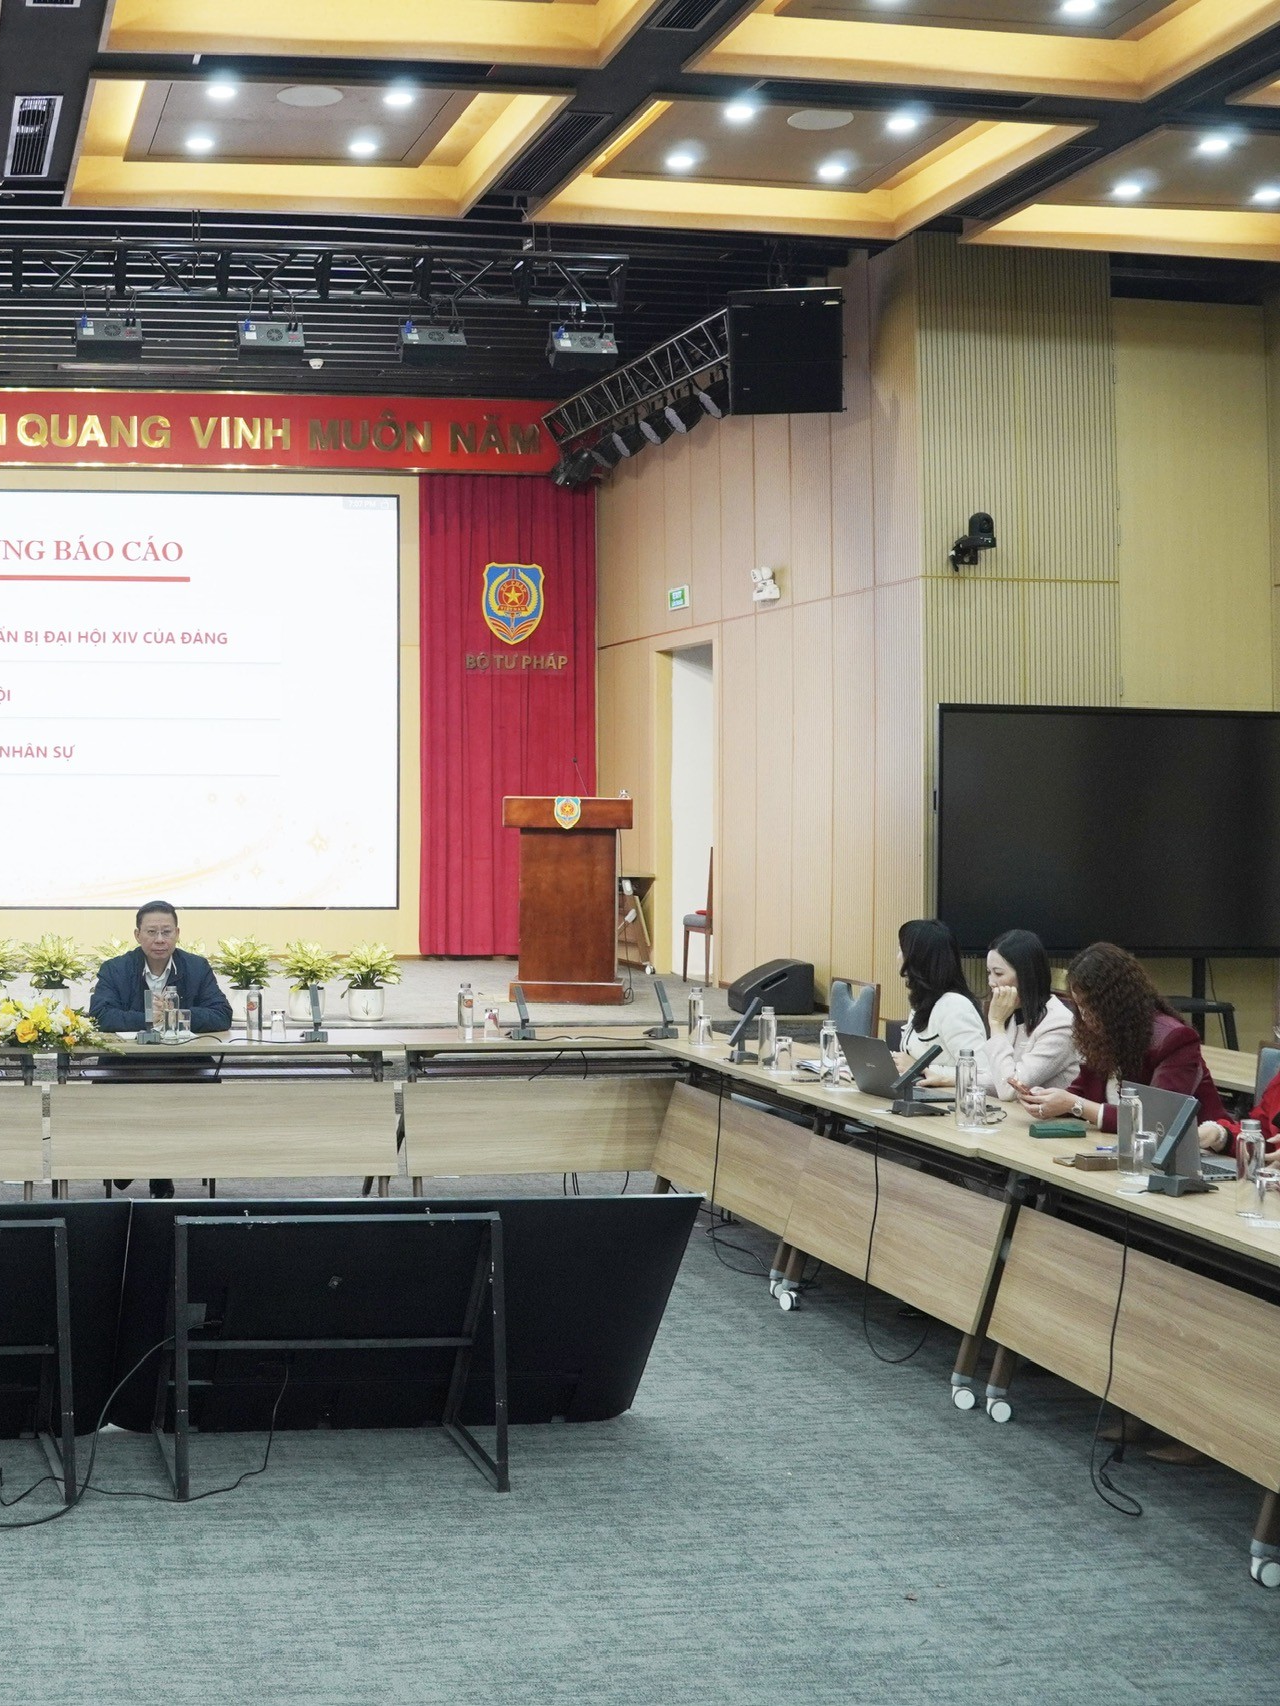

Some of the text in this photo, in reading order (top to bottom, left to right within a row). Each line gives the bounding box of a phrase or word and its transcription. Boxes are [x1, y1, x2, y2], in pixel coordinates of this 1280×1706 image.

[17, 413, 171, 449] QUANG
[190, 416, 290, 450] VINH
[309, 408, 431, 453] MUÔN
[449, 414, 541, 455] NĂM
[54, 535, 114, 561] BÁO
[121, 536, 184, 562] CÁO
[24, 630, 39, 646] BỊ
[44, 630, 71, 646] ĐẠI
[78, 628, 106, 647] HỘI
[112, 631, 138, 644] XIV
[143, 628, 176, 644] CỦA
[180, 628, 228, 645] ĐẢNG
[465, 653, 568, 672] BỘ TƯ PHÁP
[0, 743, 48, 758] NHÂN
[54, 744, 76, 761] SỰ
